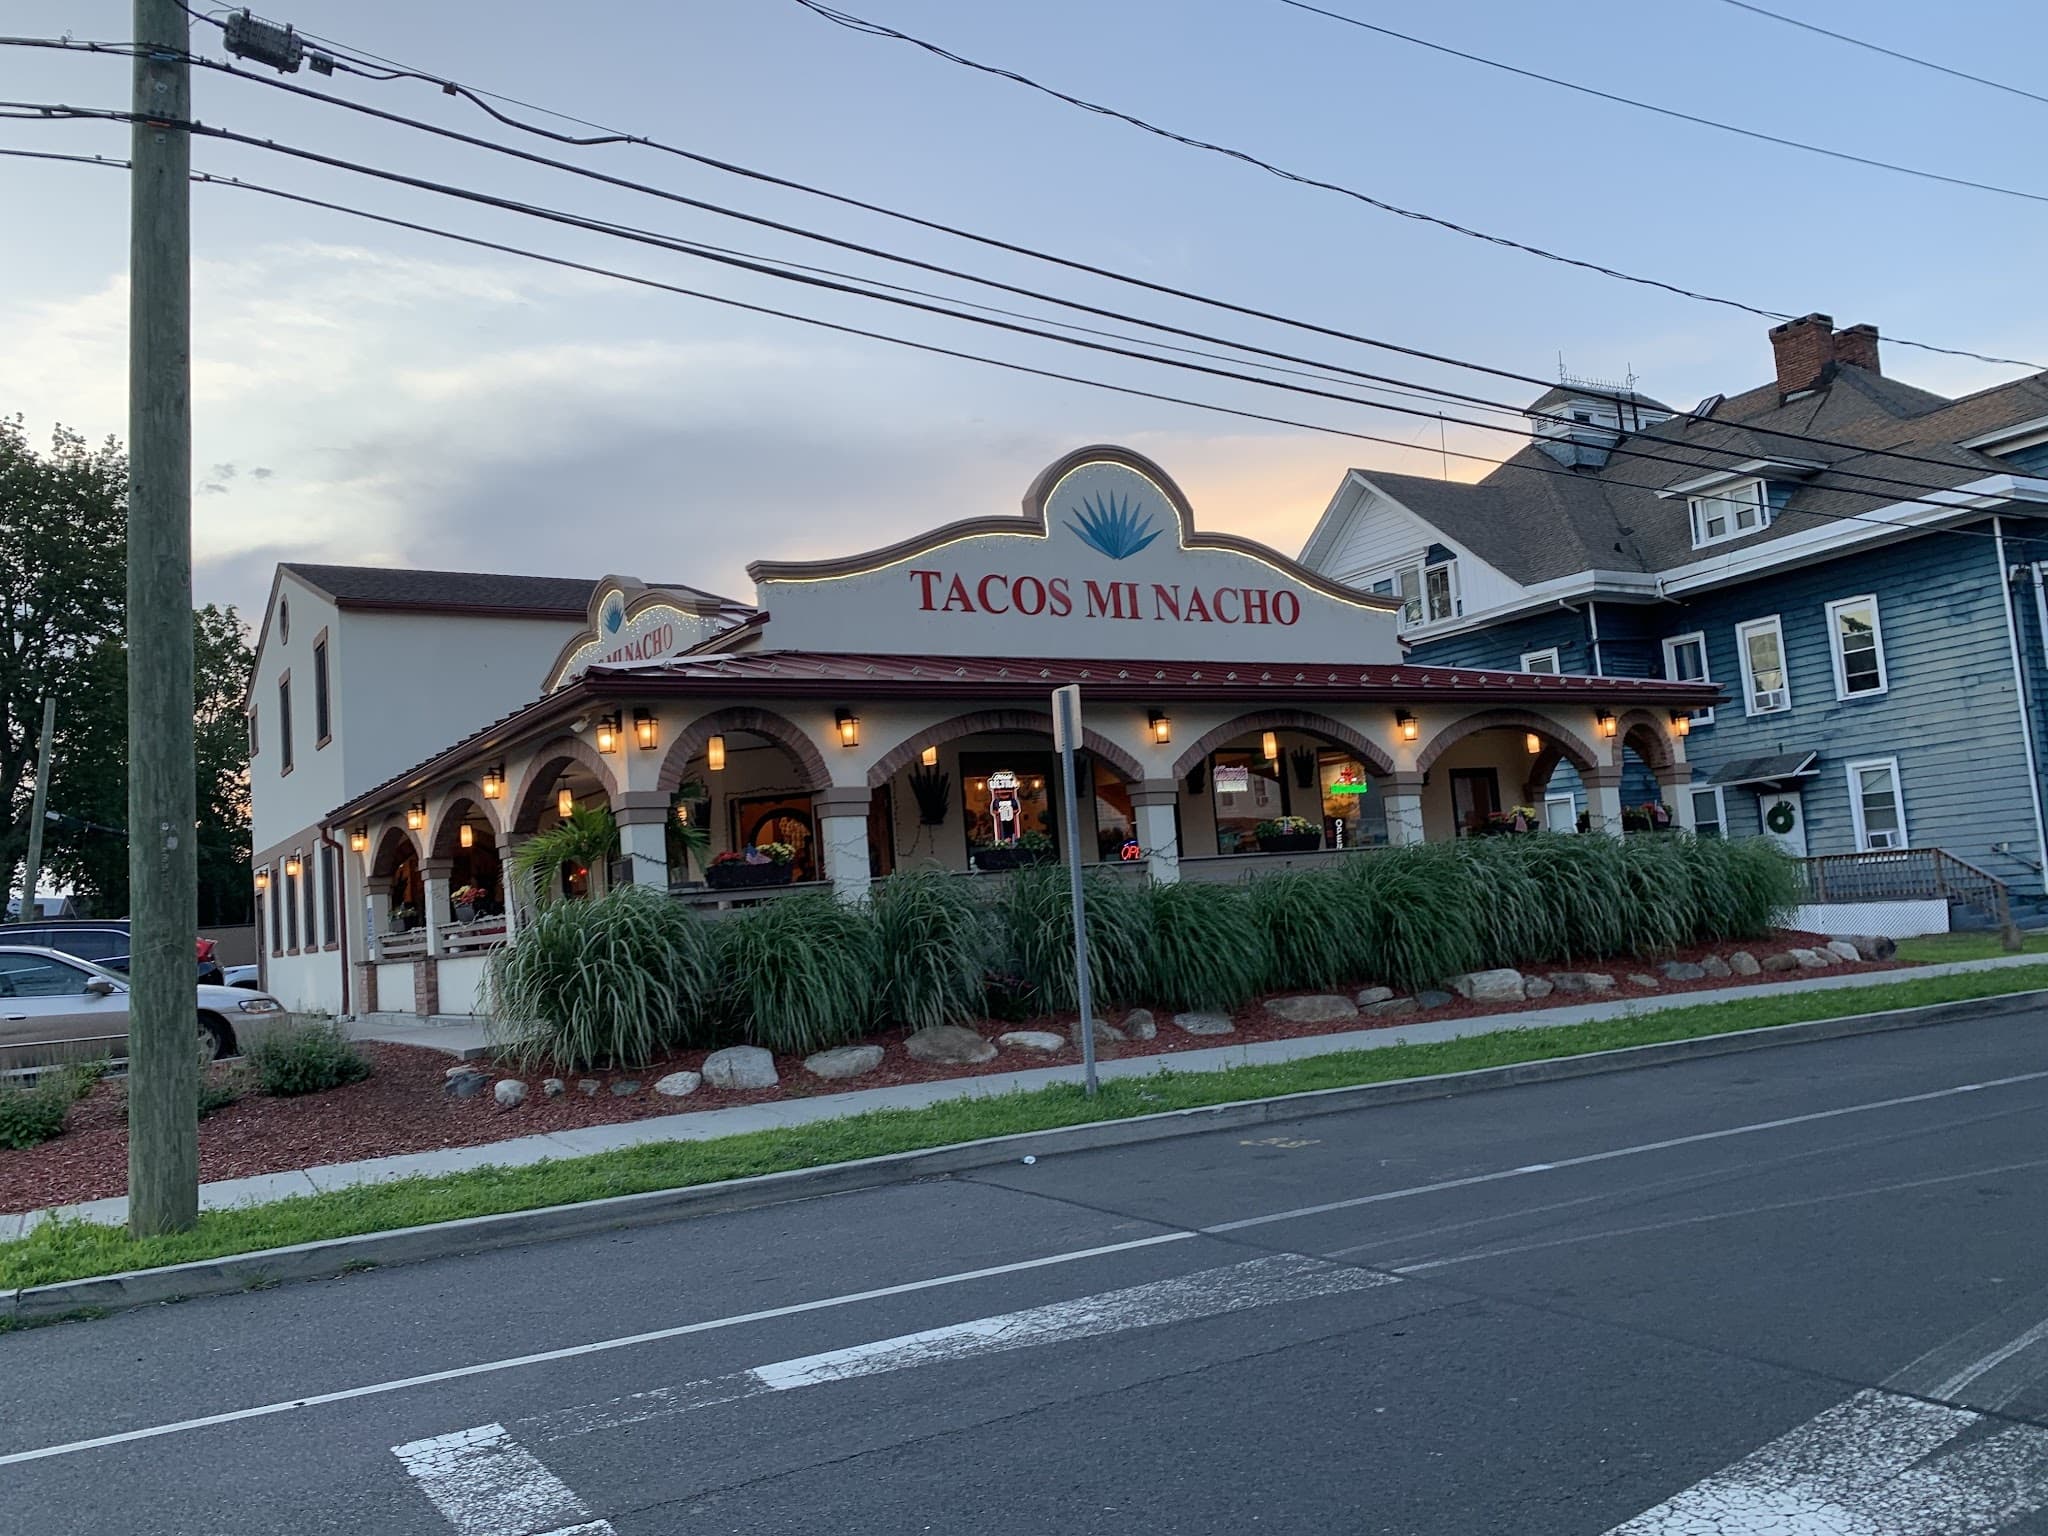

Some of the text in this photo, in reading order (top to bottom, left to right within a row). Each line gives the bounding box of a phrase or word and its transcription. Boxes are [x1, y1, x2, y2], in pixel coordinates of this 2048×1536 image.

[909, 570, 1301, 626] TACOS MI NACHO
[624, 623, 673, 662] NACHO
[1121, 845, 1140, 860] OP
